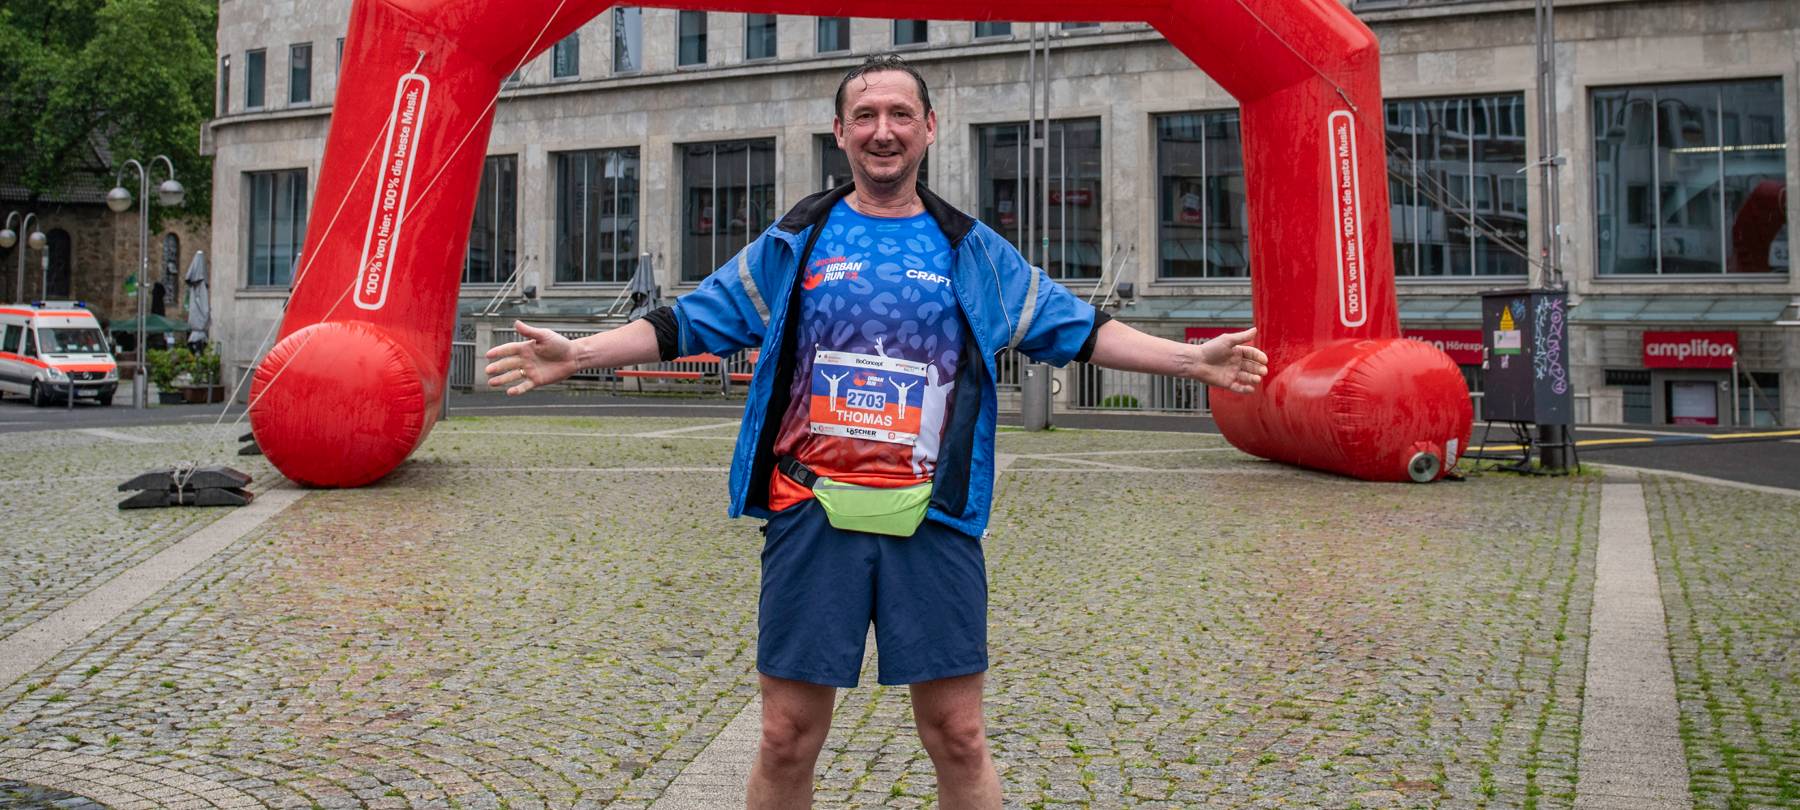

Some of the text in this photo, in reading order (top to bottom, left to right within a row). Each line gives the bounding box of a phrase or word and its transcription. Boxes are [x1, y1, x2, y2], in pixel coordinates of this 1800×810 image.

[365, 88, 419, 296] 100% von hier. 100% die beste Musik.
[1338, 123, 1359, 315] 100% von hier. 100% die beste Musik.
[826, 262, 862, 273] URBAN
[823, 271, 845, 282] RUN
[906, 269, 952, 287] CRAFT
[1446, 341, 1484, 352] Hörexp
[1645, 339, 1734, 361] amplifon
[855, 358, 884, 367] BoConcept
[847, 392, 885, 409] 2703
[836, 409, 893, 427] THOMAS
